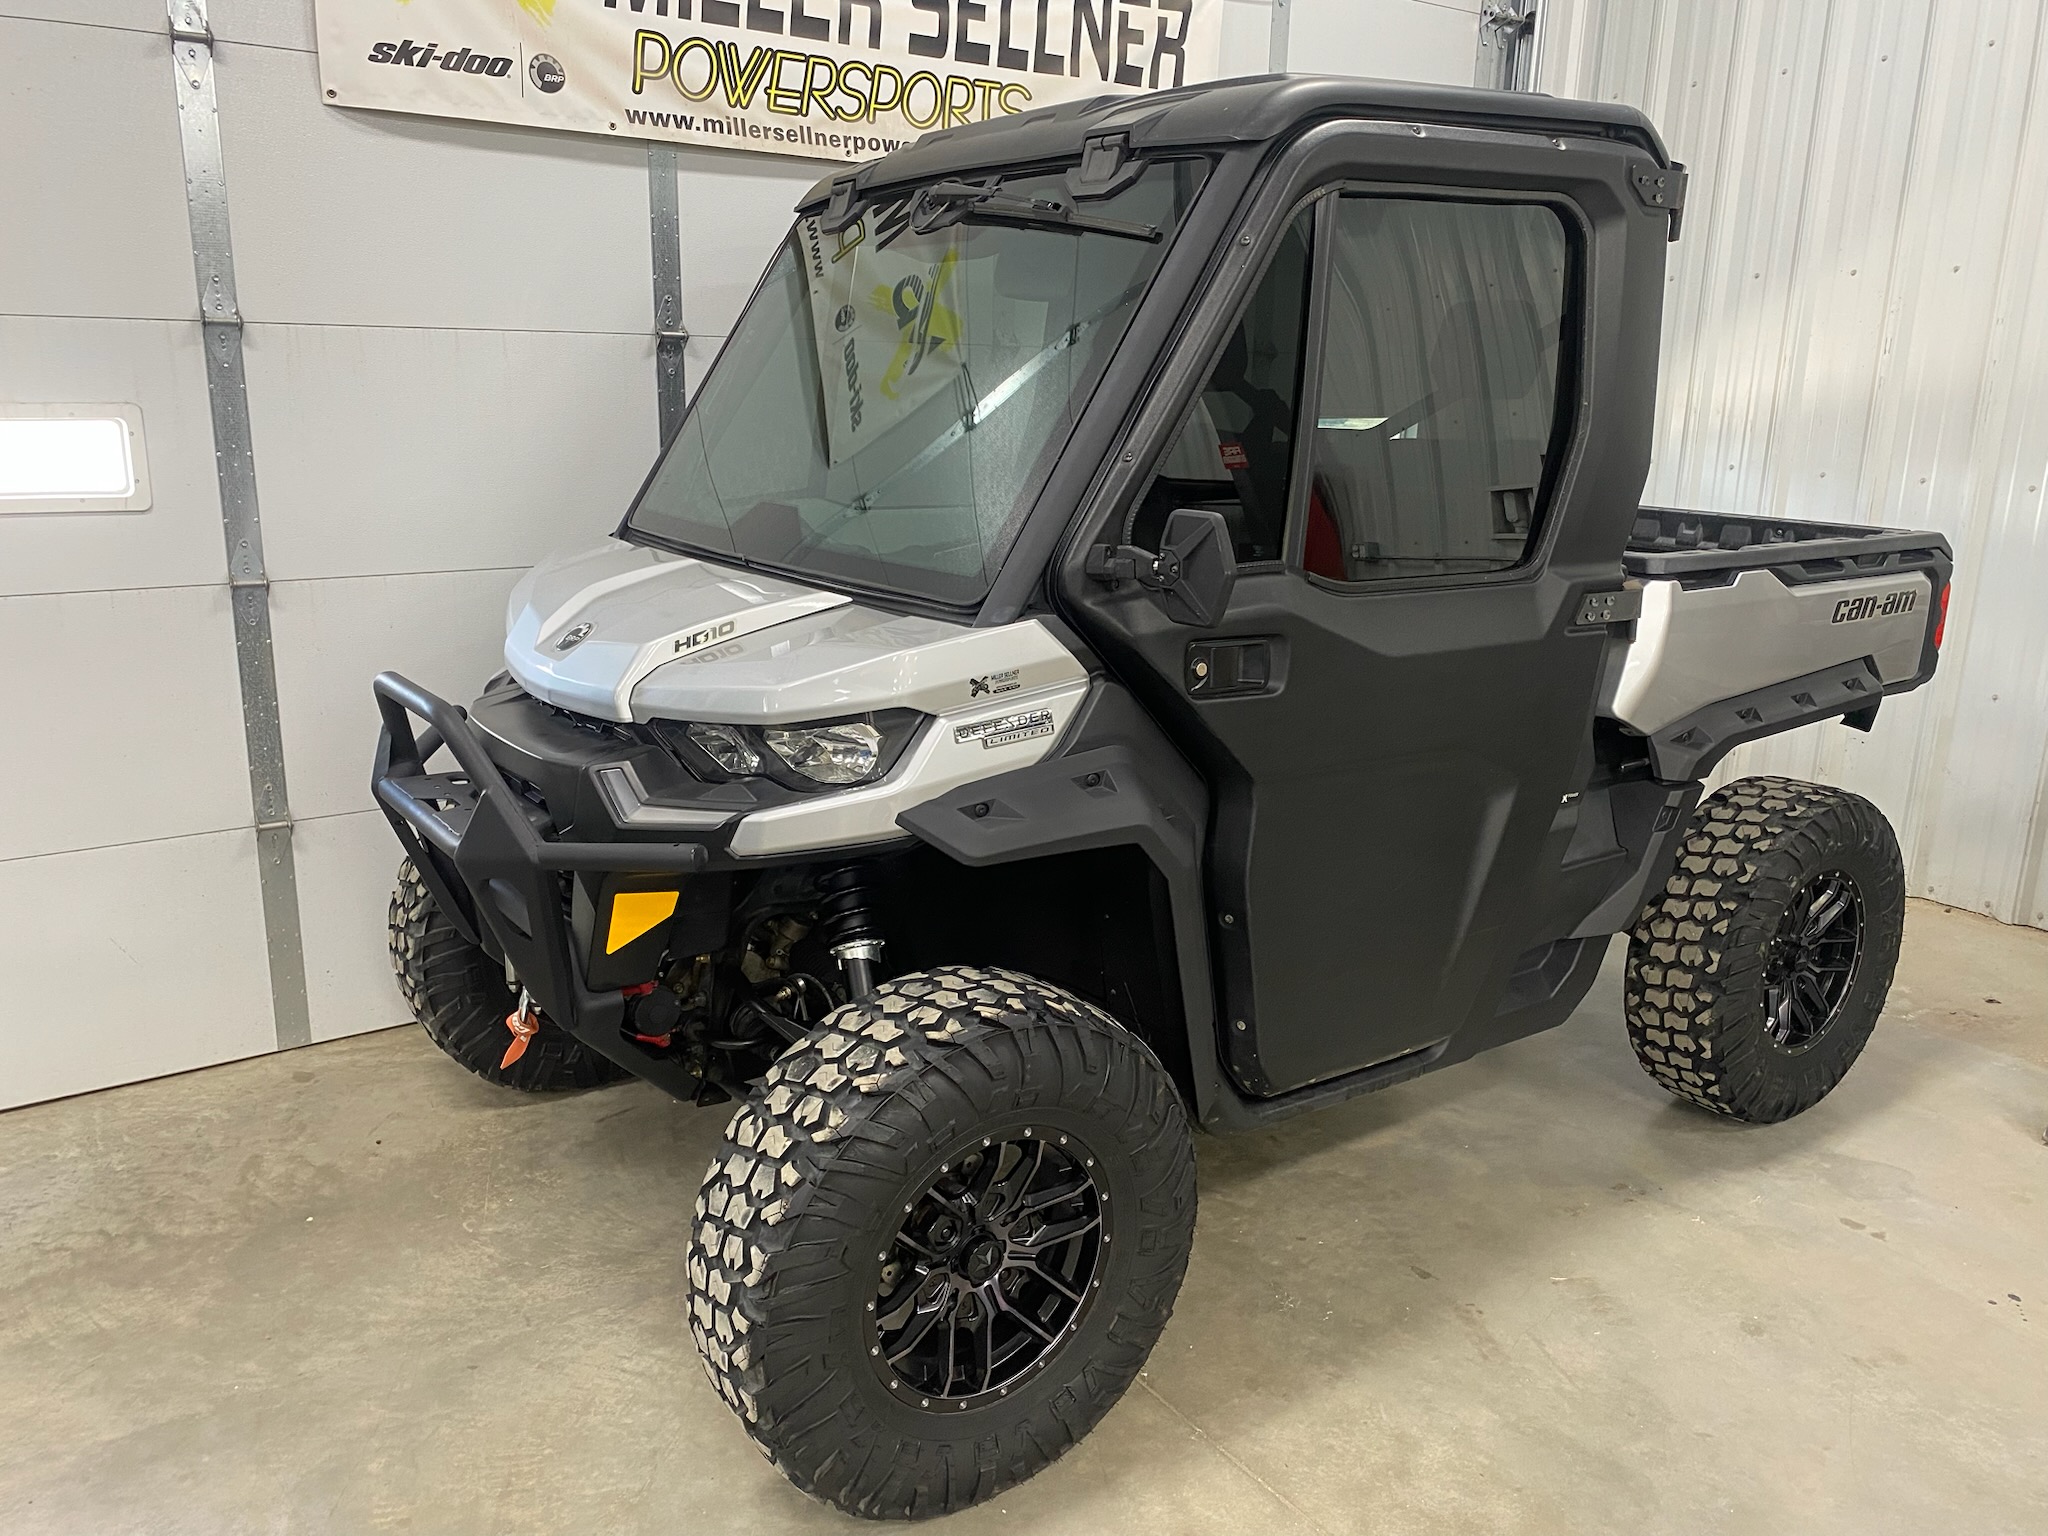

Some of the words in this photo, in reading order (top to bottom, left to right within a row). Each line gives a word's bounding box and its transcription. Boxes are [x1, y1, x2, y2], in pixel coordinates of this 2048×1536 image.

[368, 39, 514, 77] ski-doo
[544, 73, 565, 83] BRP
[1832, 589, 1917, 624] can-am
[674, 620, 735, 653] HD10
[989, 727, 1050, 745] LIMITED
